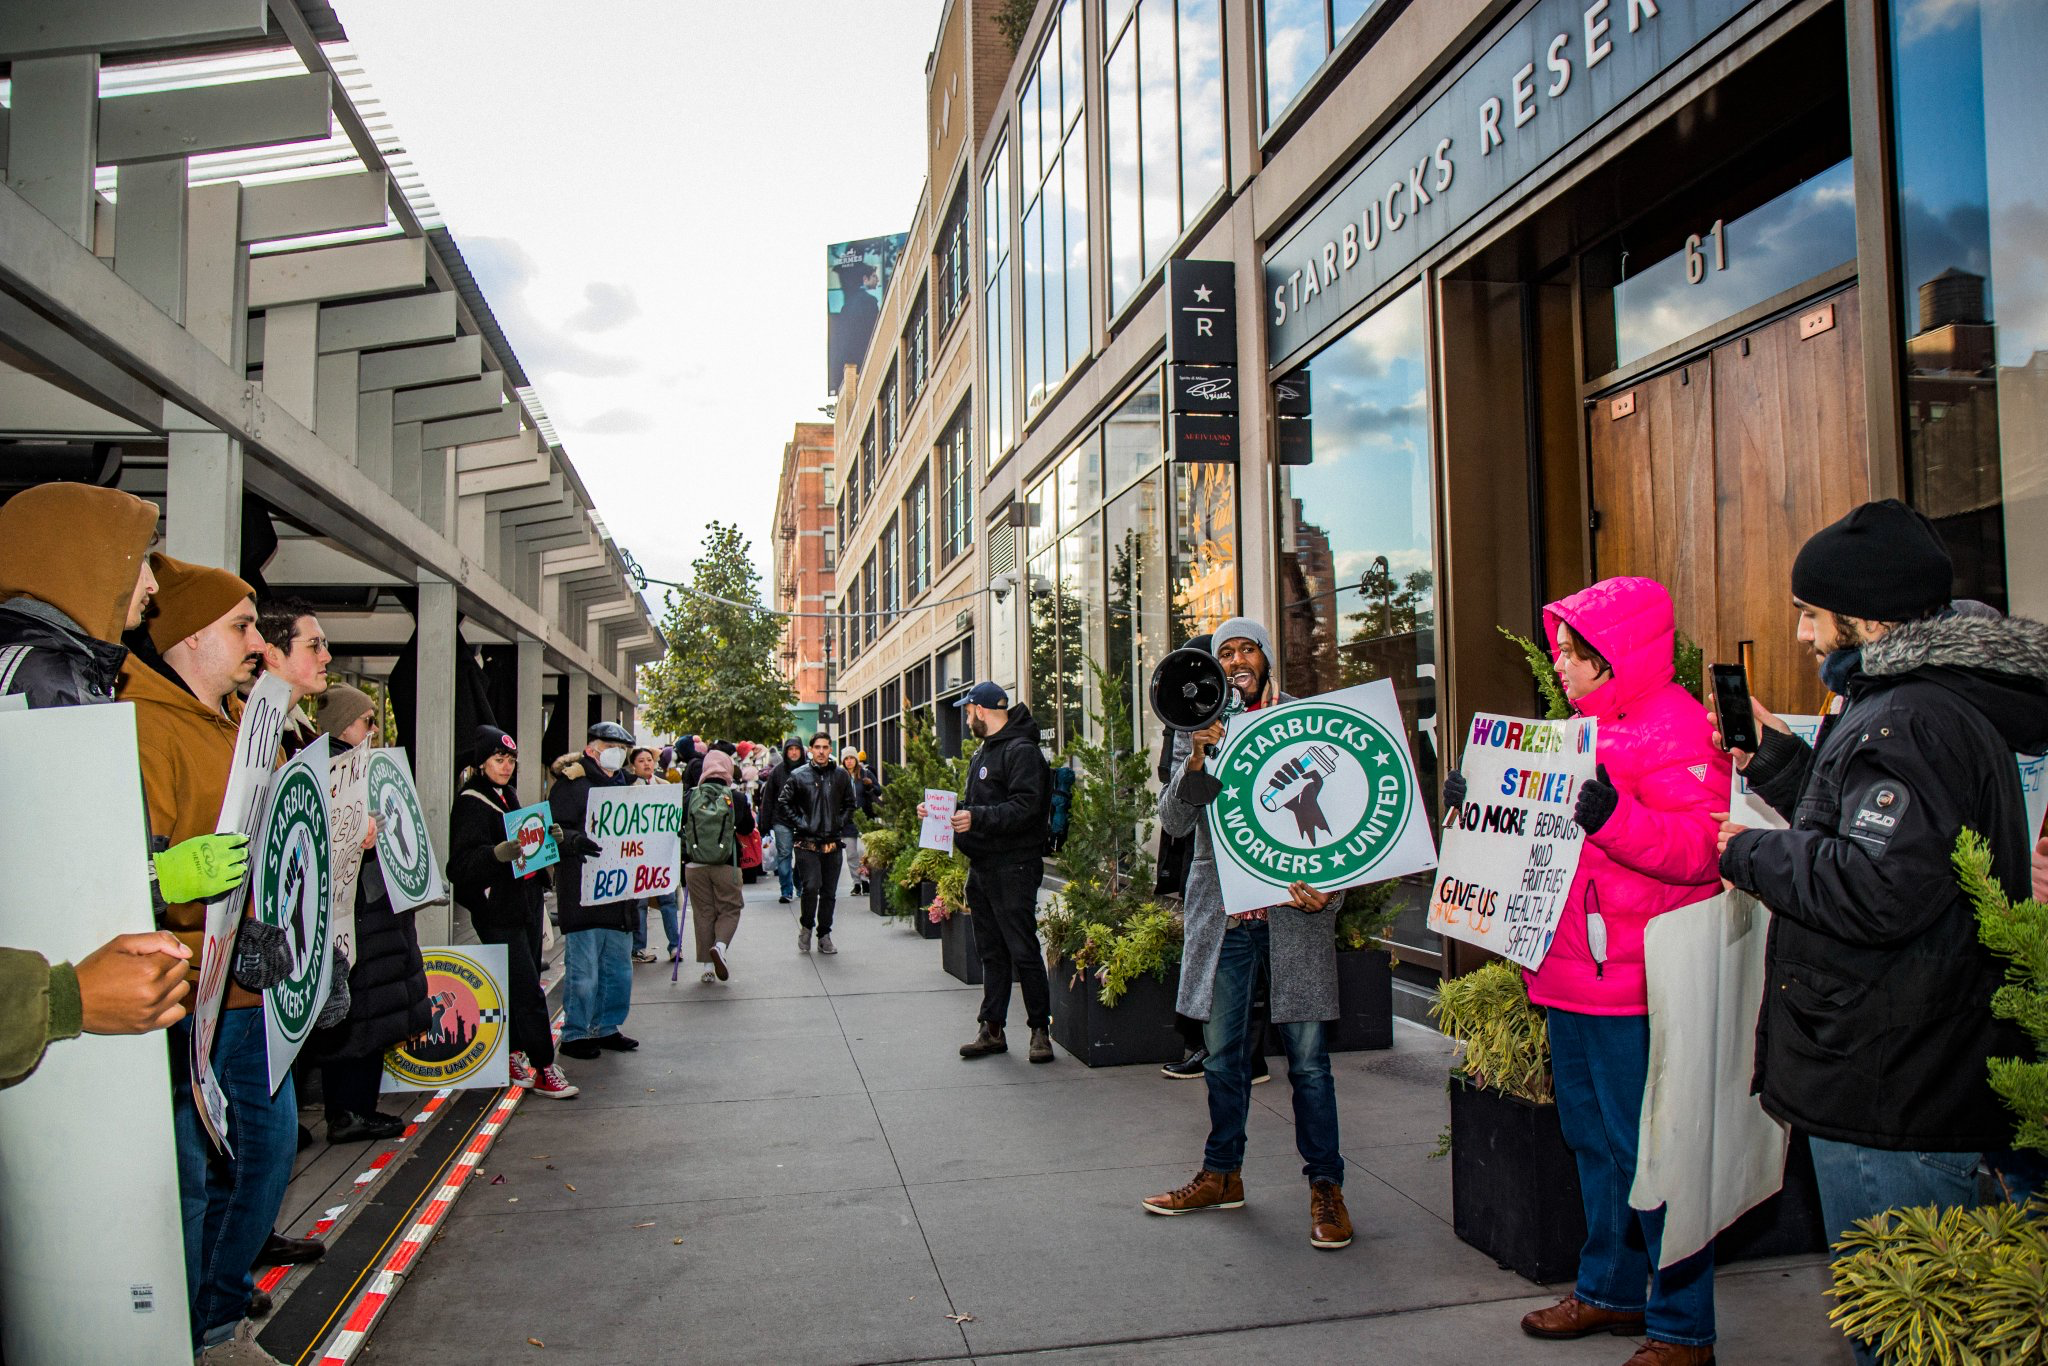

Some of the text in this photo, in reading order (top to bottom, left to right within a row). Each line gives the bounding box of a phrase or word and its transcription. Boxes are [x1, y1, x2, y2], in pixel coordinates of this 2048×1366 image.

[1274, 138, 1454, 327] STARBUCKS
[1684, 219, 1725, 285] 61
[1197, 317, 1213, 337] R
[1234, 715, 1374, 776] STARBUCKS
[1577, 720, 1591, 754] ON
[370, 757, 409, 801] STARBUCKS
[1501, 767, 1575, 805] STRIKE!
[269, 783, 322, 876] STARBUCKS
[598, 801, 682, 839] ROASTERY
[1223, 774, 1399, 875] WORKERS UNITED
[1481, 804, 1528, 836] MORE
[417, 821, 428, 881] UNITED
[620, 840, 644, 859] HAS
[1528, 843, 1553, 868] MOLD
[593, 864, 670, 900] BED BUGS
[1440, 876, 1479, 911] GIVE
[1478, 887, 1499, 918] US
[1520, 868, 1567, 894] FRUIT FLIES
[1504, 894, 1544, 924] HEALTH
[1545, 895, 1556, 924] &
[309, 870, 328, 986] UNITED
[1504, 925, 1546, 962] SAFETY
[423, 960, 483, 989] TARBUCKS
[393, 1041, 486, 1077] ORKERS UNITED
